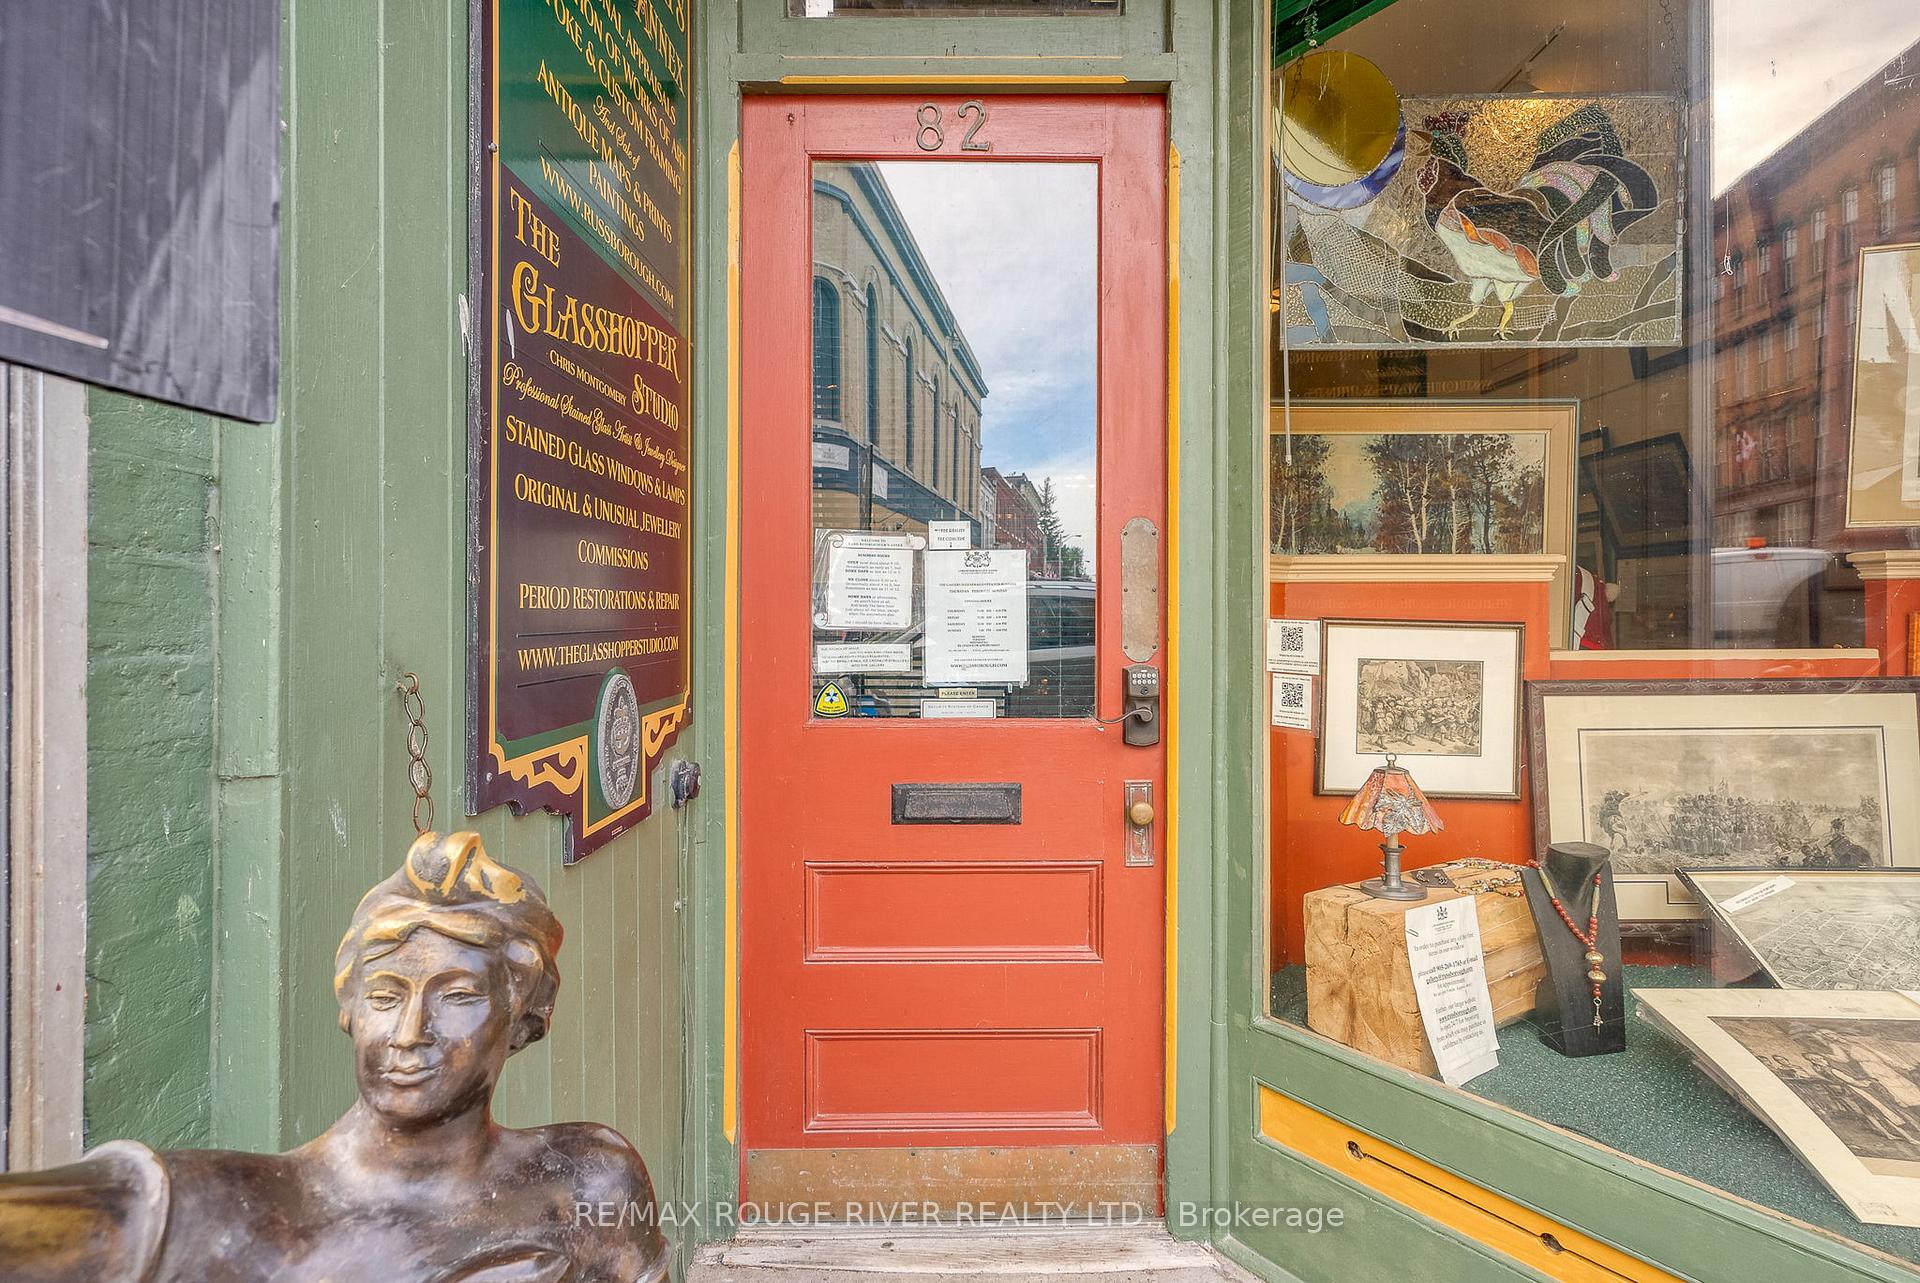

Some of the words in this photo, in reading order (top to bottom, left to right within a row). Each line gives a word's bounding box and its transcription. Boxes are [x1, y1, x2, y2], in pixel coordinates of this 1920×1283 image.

[605, 31, 621, 68] OF
[622, 55, 658, 128] WORKS
[659, 118, 671, 147] OF
[671, 138, 686, 172] ART
[625, 29, 676, 126] APPRAISALS
[585, 40, 596, 74] &
[598, 58, 643, 141] CUSTOM
[644, 125, 681, 196] FRAMING
[593, 95, 616, 136] And
[916, 100, 991, 152] 82
[536, 58, 599, 154] ANTIQUE
[601, 136, 632, 194] MAPS
[632, 181, 643, 208] &
[643, 190, 673, 245] PRINTS
[510, 186, 561, 269] THE
[588, 159, 646, 243] PAINTINGS
[511, 260, 682, 385] GLASSHOPPER
[502, 361, 561, 411] Professional
[560, 394, 594, 427] Stained
[549, 349, 577, 377] CHRIS
[576, 365, 628, 408] MONTGOMERY
[631, 373, 680, 432] STUDIO
[505, 415, 567, 462] STAINED
[568, 441, 606, 476] GLASS
[606, 457, 654, 496] WINDOWS
[654, 477, 662, 498] &
[662, 480, 686, 506] LAMPS
[514, 473, 581, 515] ORIGINAL
[582, 493, 593, 519] &
[594, 497, 640, 530] UNUSUAL
[639, 511, 682, 540] JEWELLERY
[577, 539, 650, 571] COMMISSIONS
[519, 583, 571, 610] PERIOD
[573, 586, 647, 611] RESTORATIONS
[647, 590, 655, 611] &
[655, 592, 680, 611] REPAIR
[517, 635, 680, 672] WWW.THEGLASSHOPPERSTUDIO.COM
